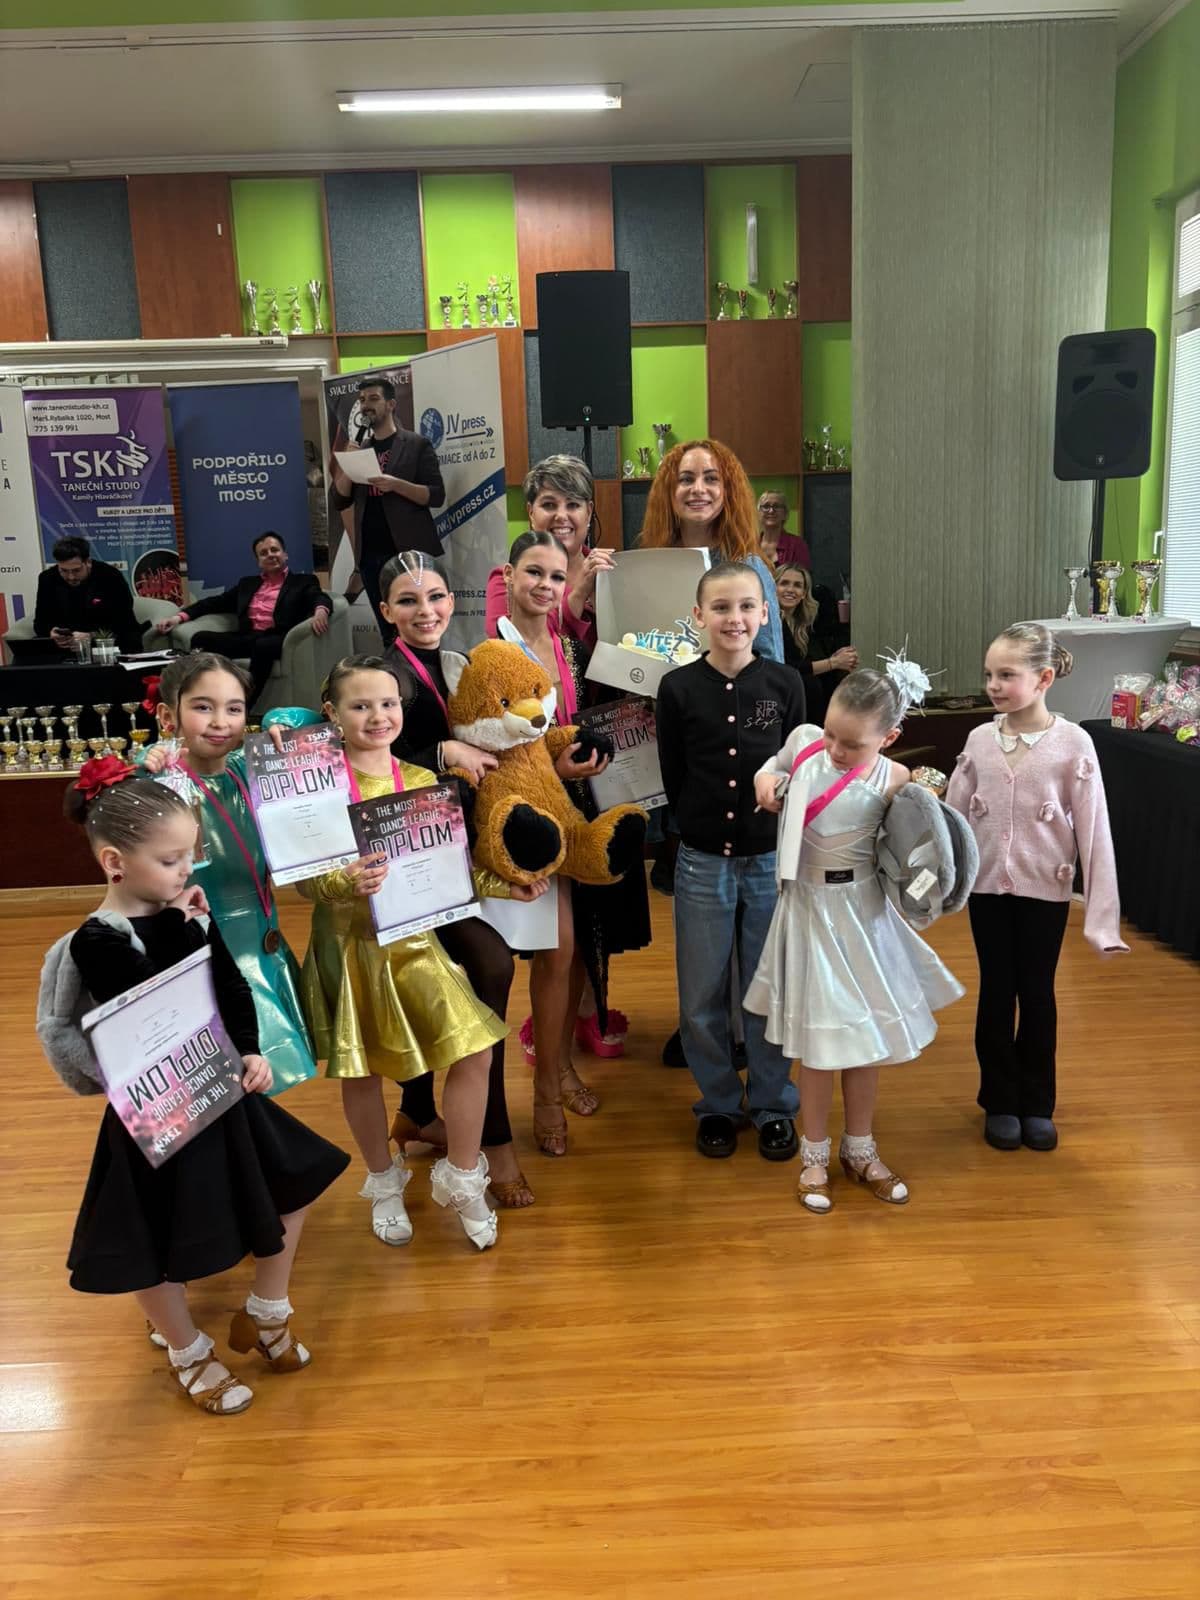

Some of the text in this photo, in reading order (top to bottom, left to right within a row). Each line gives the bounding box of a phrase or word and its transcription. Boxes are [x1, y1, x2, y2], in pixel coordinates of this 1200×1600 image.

[329, 385, 346, 397] SVAZ
[96, 413, 111, 421] Most
[446, 413, 486, 435] JV press
[34, 425, 48, 433] 775
[65, 424, 79, 432] 991
[192, 452, 287, 470] PODPOŘILO
[463, 451, 472, 462] od
[473, 450, 479, 461] A
[479, 449, 488, 460] do
[489, 447, 496, 459] Z
[62, 481, 141, 492] TANEČNÍ STUDIO
[213, 470, 269, 486] MĚSTO
[265, 758, 291, 772] DANCE
[258, 765, 337, 802] DIPLOM
[376, 799, 417, 818] THE MOST
[380, 818, 407, 834] DANCE
[369, 820, 454, 865] DIPLOM
[126, 1026, 220, 1114] DIPLOM
[187, 1065, 217, 1095] DANCE
[184, 1081, 229, 1122] THE MOST
